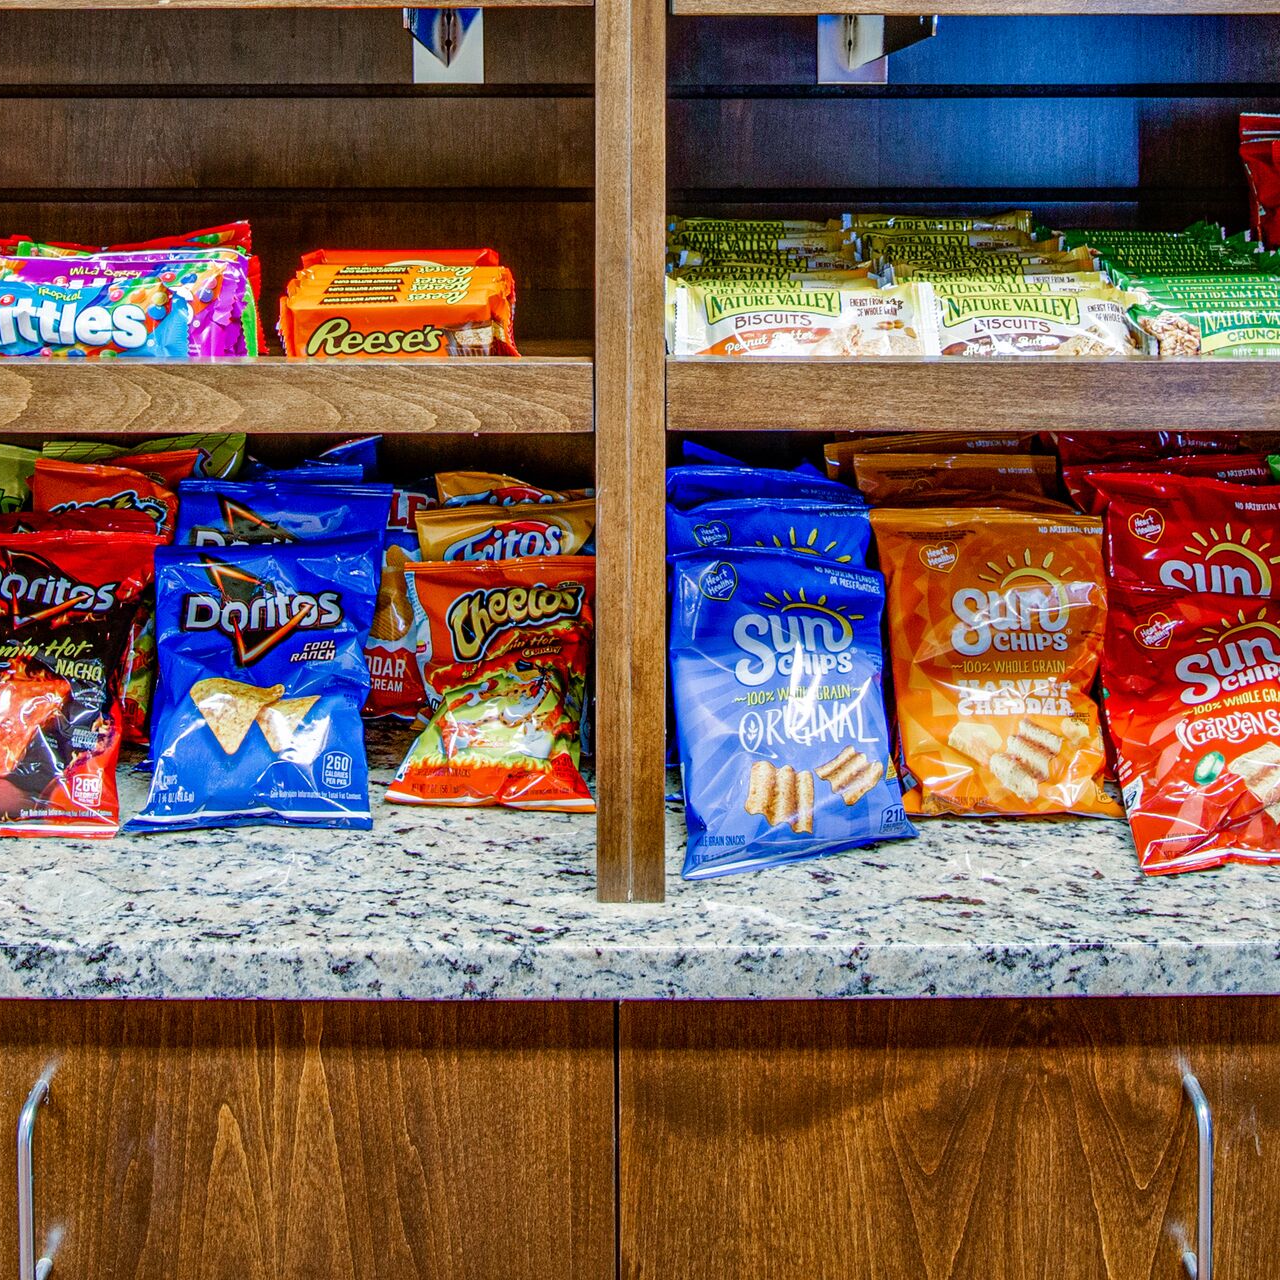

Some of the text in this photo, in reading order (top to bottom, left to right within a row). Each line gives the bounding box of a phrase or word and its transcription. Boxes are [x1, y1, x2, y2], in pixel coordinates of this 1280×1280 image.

[709, 291, 837, 320] NATURE VALLEY
[946, 296, 1073, 322] NATURE VALLEY
[734, 314, 813, 330] BISCUITS
[973, 318, 1051, 334] BISCUITS
[1203, 309, 1258, 335] NATURE
[307, 317, 444, 356] Reese's
[1133, 517, 1156, 527] Heart
[1134, 523, 1162, 537] Healthy
[442, 523, 562, 562] Fritos
[926, 545, 950, 558] Heart
[926, 553, 956, 567] Healthy
[704, 570, 727, 585] Heart
[1159, 558, 1273, 596] Sun
[707, 578, 736, 597] Healthy
[184, 592, 343, 632] Doritos
[950, 584, 1070, 657] Sun
[449, 583, 585, 661] Cheetos
[1139, 622, 1163, 638] Heart
[303, 641, 336, 652] COOL
[732, 611, 854, 687] Sun
[993, 631, 1069, 652] CHIPS
[289, 650, 336, 663] RANCH
[778, 651, 853, 676] CHIPS
[54, 659, 103, 683] NACHO
[962, 659, 1067, 674] 100% WHOLE GRAIN
[368, 678, 404, 693] CREAM
[957, 696, 1075, 718] CHEDDAR
[1193, 701, 1222, 716] 100%
[1223, 690, 1262, 708] WHOLE
[325, 755, 350, 772] 260
[324, 770, 349, 780] CALORIES
[74, 776, 102, 793] 260
[885, 808, 905, 823] 210
